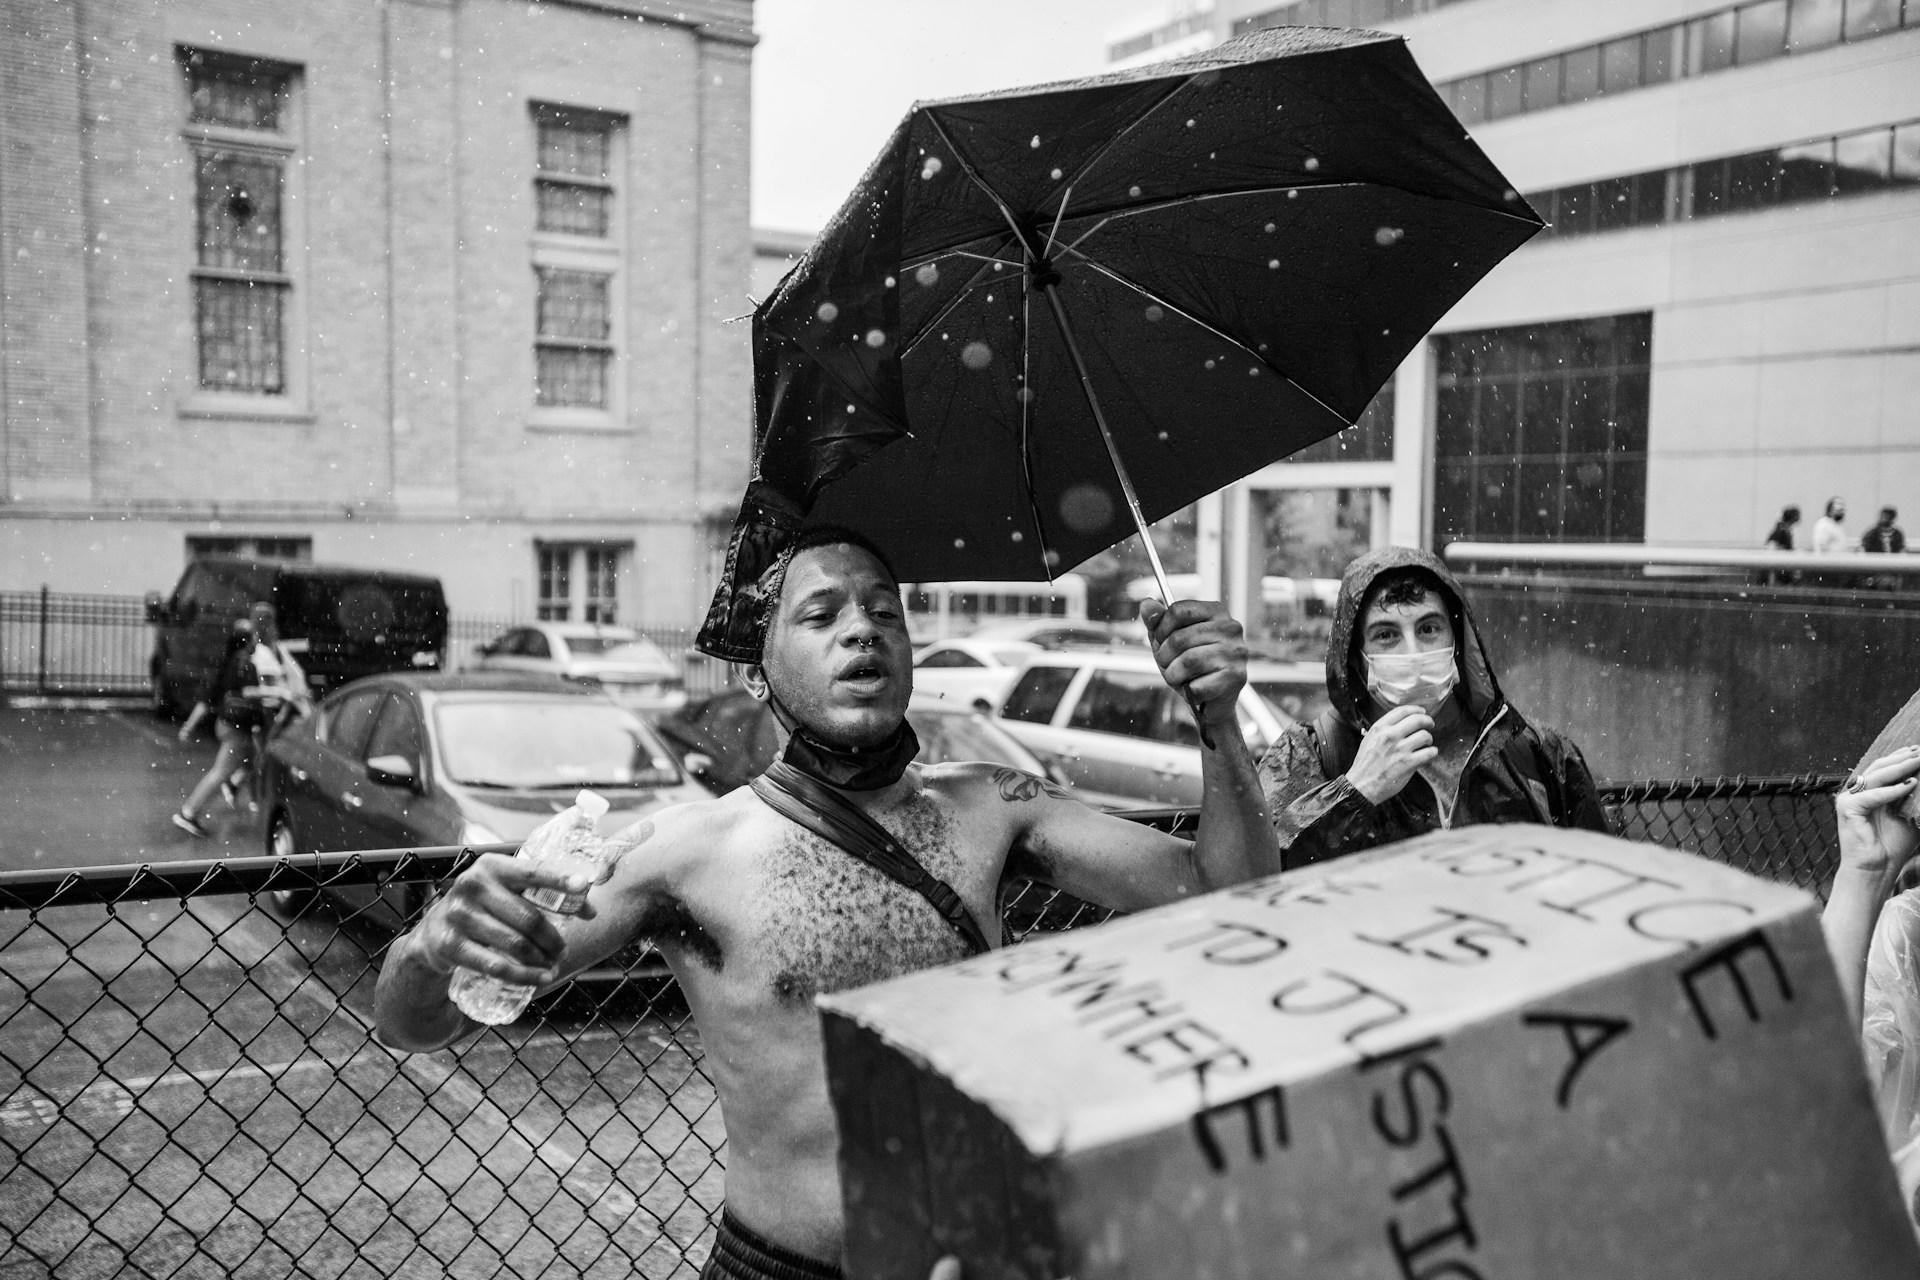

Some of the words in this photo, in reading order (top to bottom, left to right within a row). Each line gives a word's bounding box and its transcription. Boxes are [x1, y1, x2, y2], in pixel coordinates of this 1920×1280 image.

[1352, 904, 1530, 966] IS
[1519, 1011, 1632, 1109] A
[1362, 838, 1795, 1040] USTICE
[1163, 918, 1291, 967] TO
[1269, 966, 1485, 1280] JUSTI
